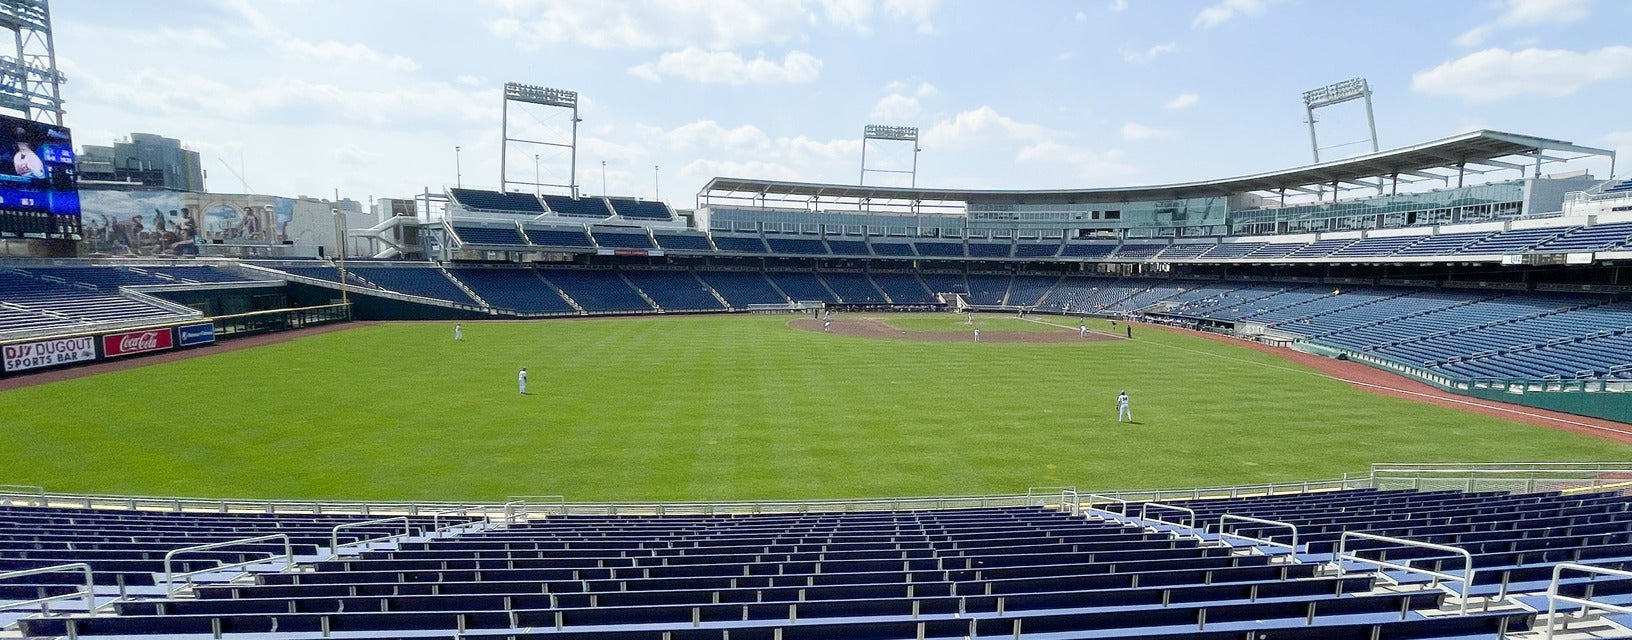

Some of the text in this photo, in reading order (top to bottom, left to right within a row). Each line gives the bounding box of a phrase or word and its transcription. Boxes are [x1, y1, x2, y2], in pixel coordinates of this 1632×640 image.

[5, 338, 92, 360] DJ7 DUGOUT
[7, 352, 78, 369] SPORTS BAR
